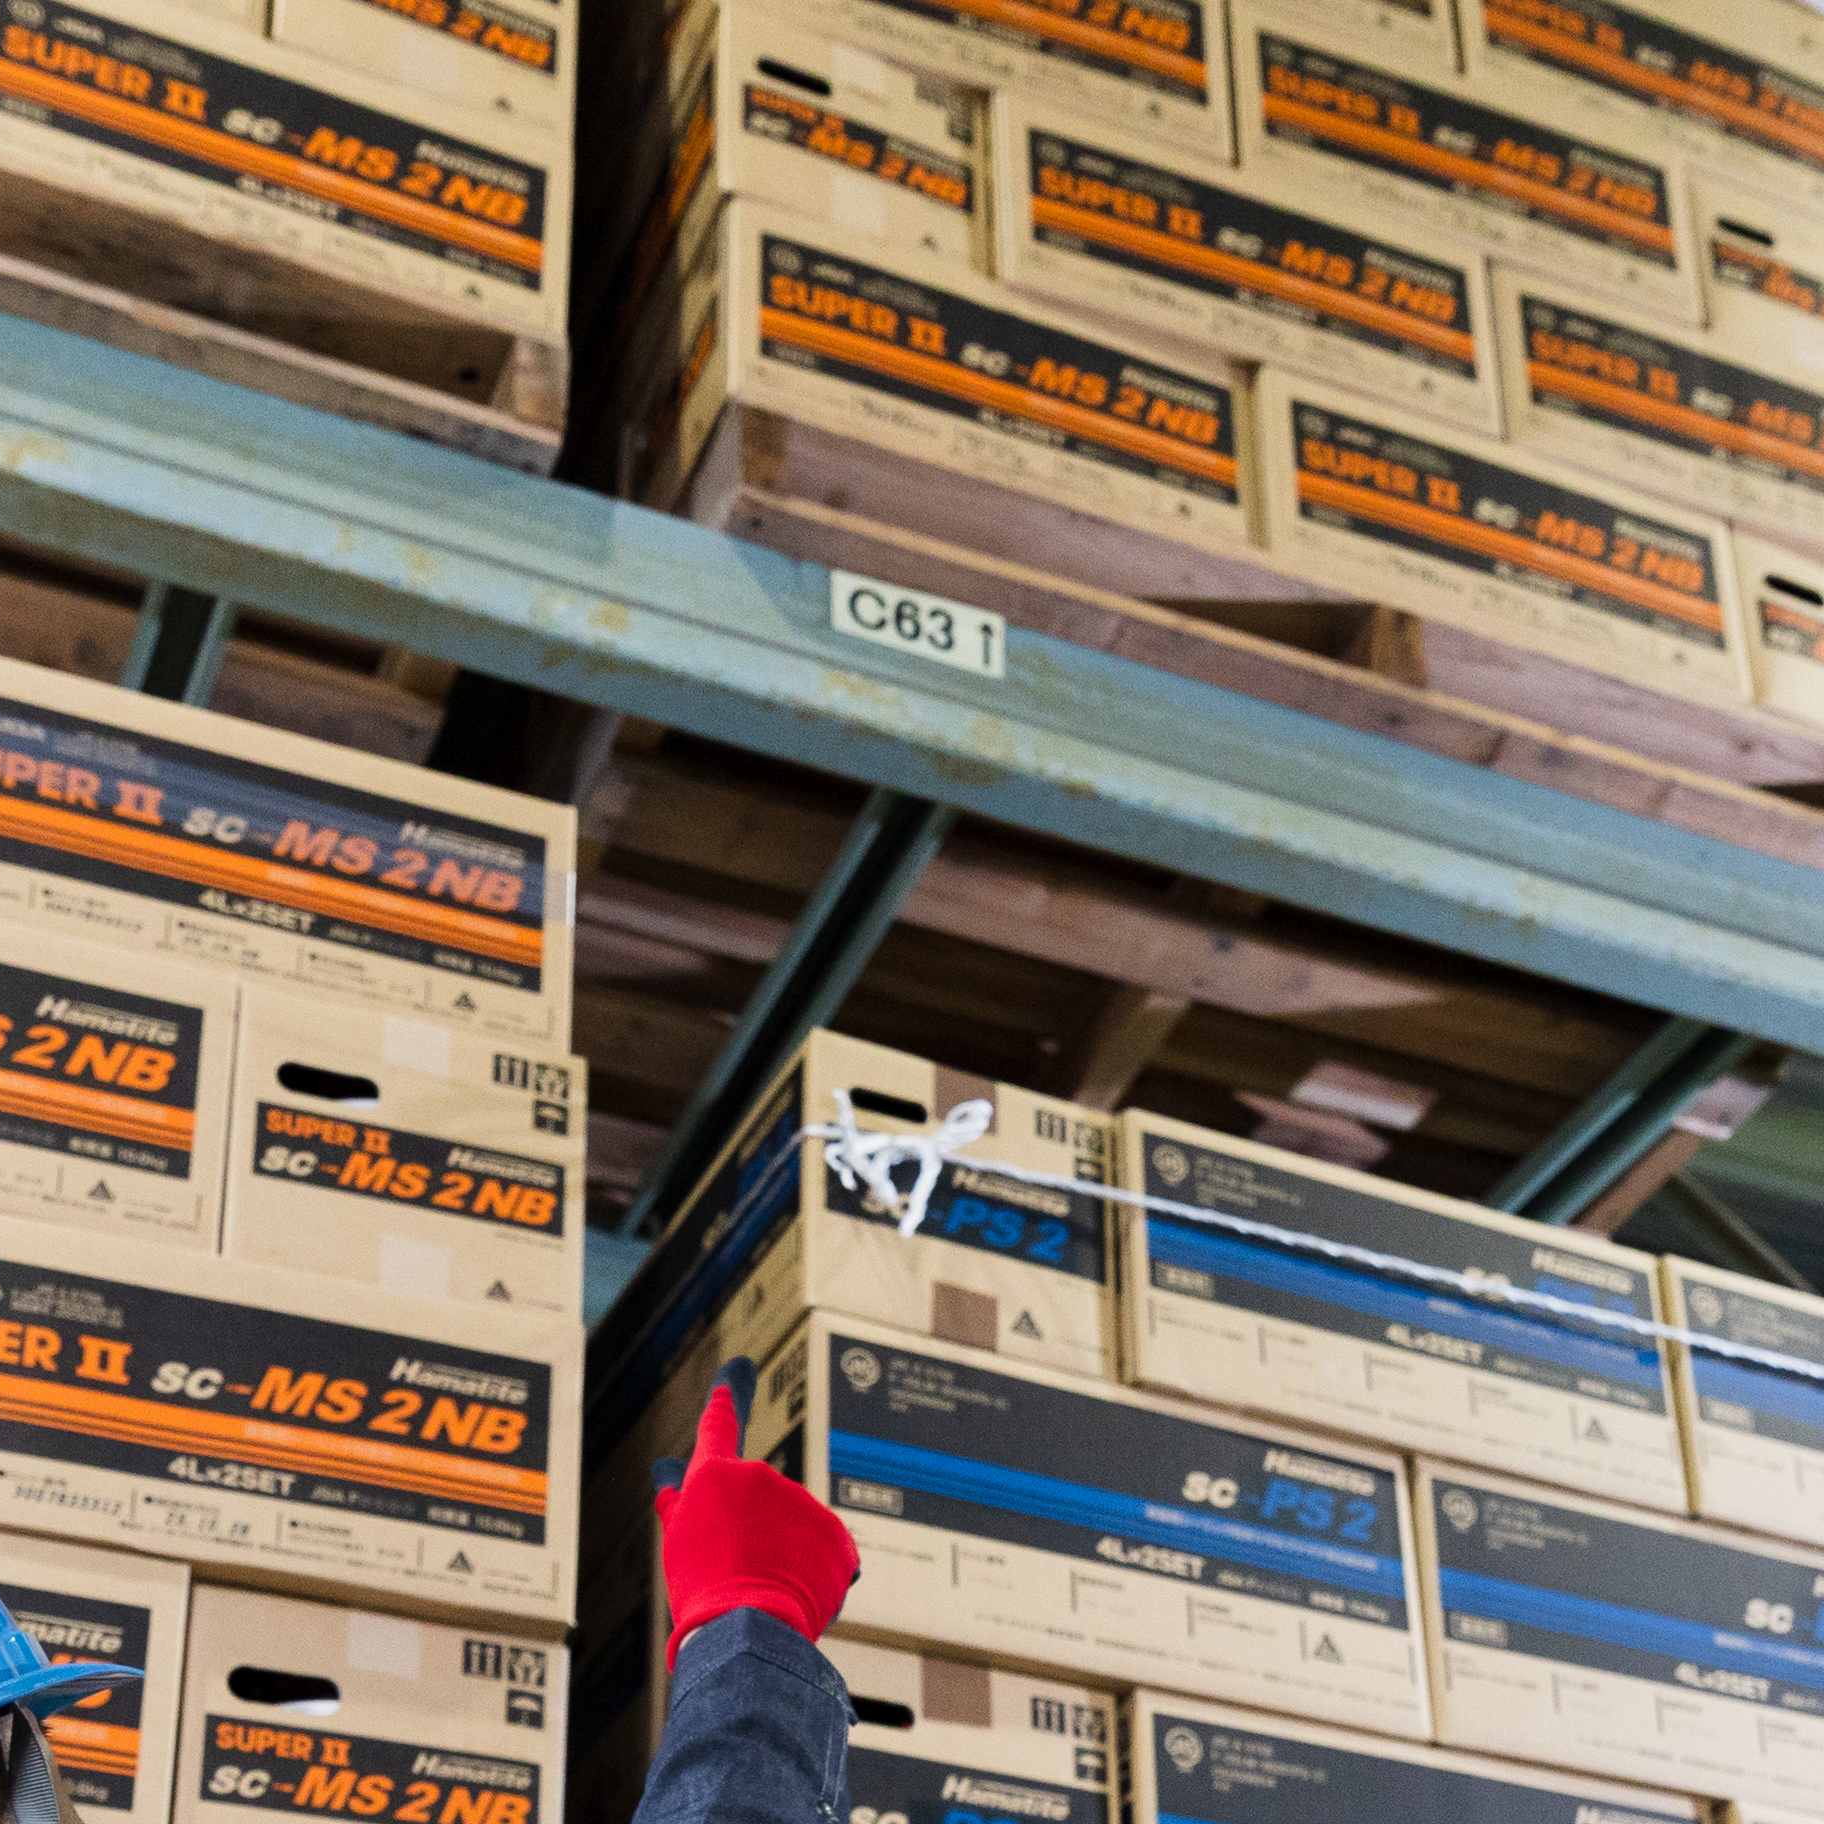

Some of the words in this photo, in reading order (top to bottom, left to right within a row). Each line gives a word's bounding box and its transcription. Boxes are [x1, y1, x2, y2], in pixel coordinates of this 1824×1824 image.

[844, 586, 958, 656] C63
[32, 992, 181, 1049] Hamatite
[265, 1109, 355, 1149] SUPER
[446, 1147, 555, 1190] Hamatite
[70, 1333, 132, 1386] II
[386, 1356, 529, 1409] Hamatite
[215, 1721, 313, 1761] SUPER
[412, 1752, 530, 1793] Hamatite
